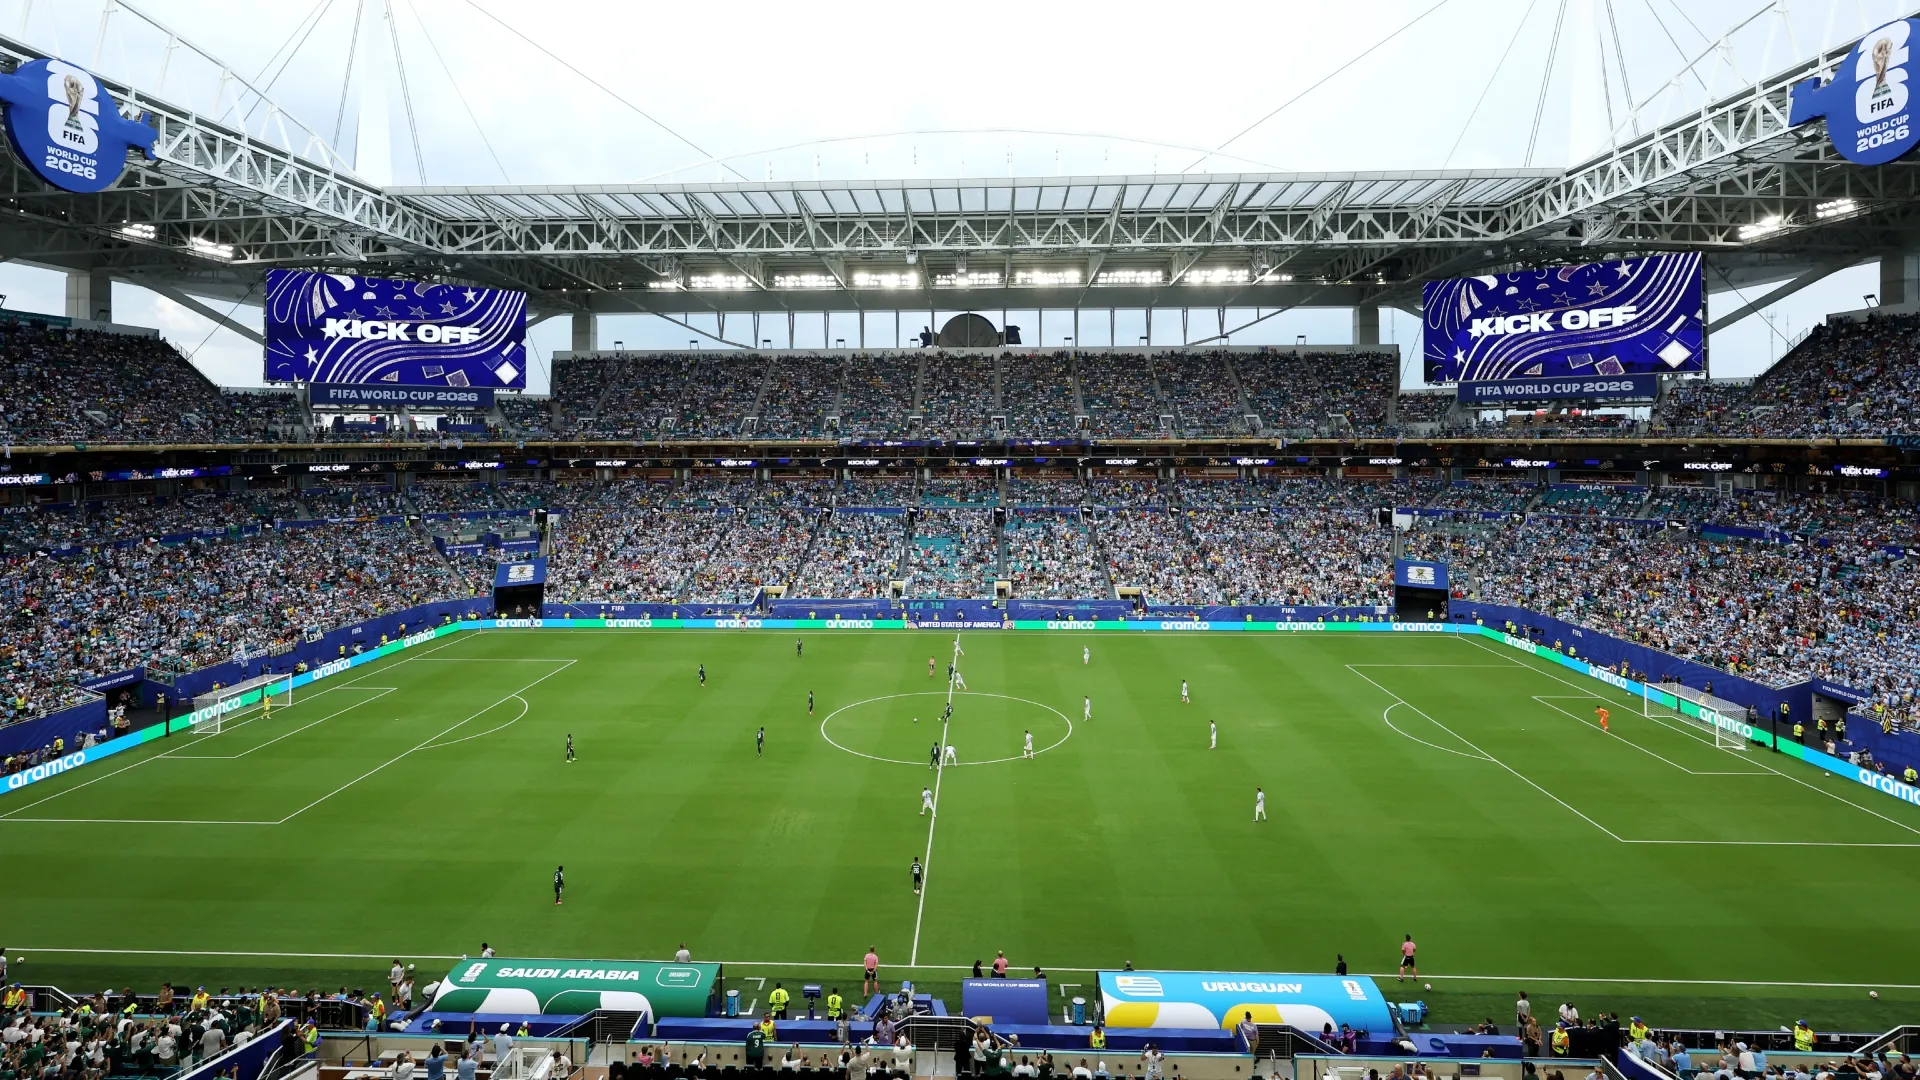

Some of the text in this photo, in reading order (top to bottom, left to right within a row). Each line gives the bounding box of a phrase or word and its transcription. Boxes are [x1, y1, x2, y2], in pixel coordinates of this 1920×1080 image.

[1870, 98, 1894, 114] FIFA
[1857, 114, 1909, 138] WORLD CUP
[63, 130, 85, 145] FIFA
[1856, 125, 1910, 152] 2026
[47, 146, 97, 168] WORLD CUP
[45, 155, 96, 180] 2026
[1470, 306, 1636, 336] KICK OFF
[325, 318, 480, 344] KICK OFF
[330, 389, 478, 401] FIFA WORLD CUP 2026
[1475, 381, 1634, 396] FIFA WORLD CUP 2026
[1840, 467, 1861, 475] KICK
[22, 475, 42, 483] OFF
[496, 618, 542, 627] aramco
[606, 619, 652, 628] aramco
[715, 619, 762, 628] aramco
[825, 619, 873, 629] aramco
[1046, 620, 1096, 630] aramco
[1161, 622, 1210, 630] aramco
[1276, 622, 1325, 631] aramco
[1392, 622, 1443, 632] aramco
[352, 627, 362, 635] FIFA
[1572, 628, 1582, 638] FIFA
[403, 630, 436, 648] aramco
[1504, 634, 1536, 653] aramco
[312, 658, 351, 680] aramco
[1588, 666, 1627, 689] aramco
[1832, 688, 1847, 697] WORLD
[189, 697, 241, 724] aramco
[1699, 708, 1752, 738] aramco
[8, 752, 85, 789] aramco
[496, 967, 639, 980] SAUDI ARABIA
[1202, 981, 1302, 993] URUGUAY
